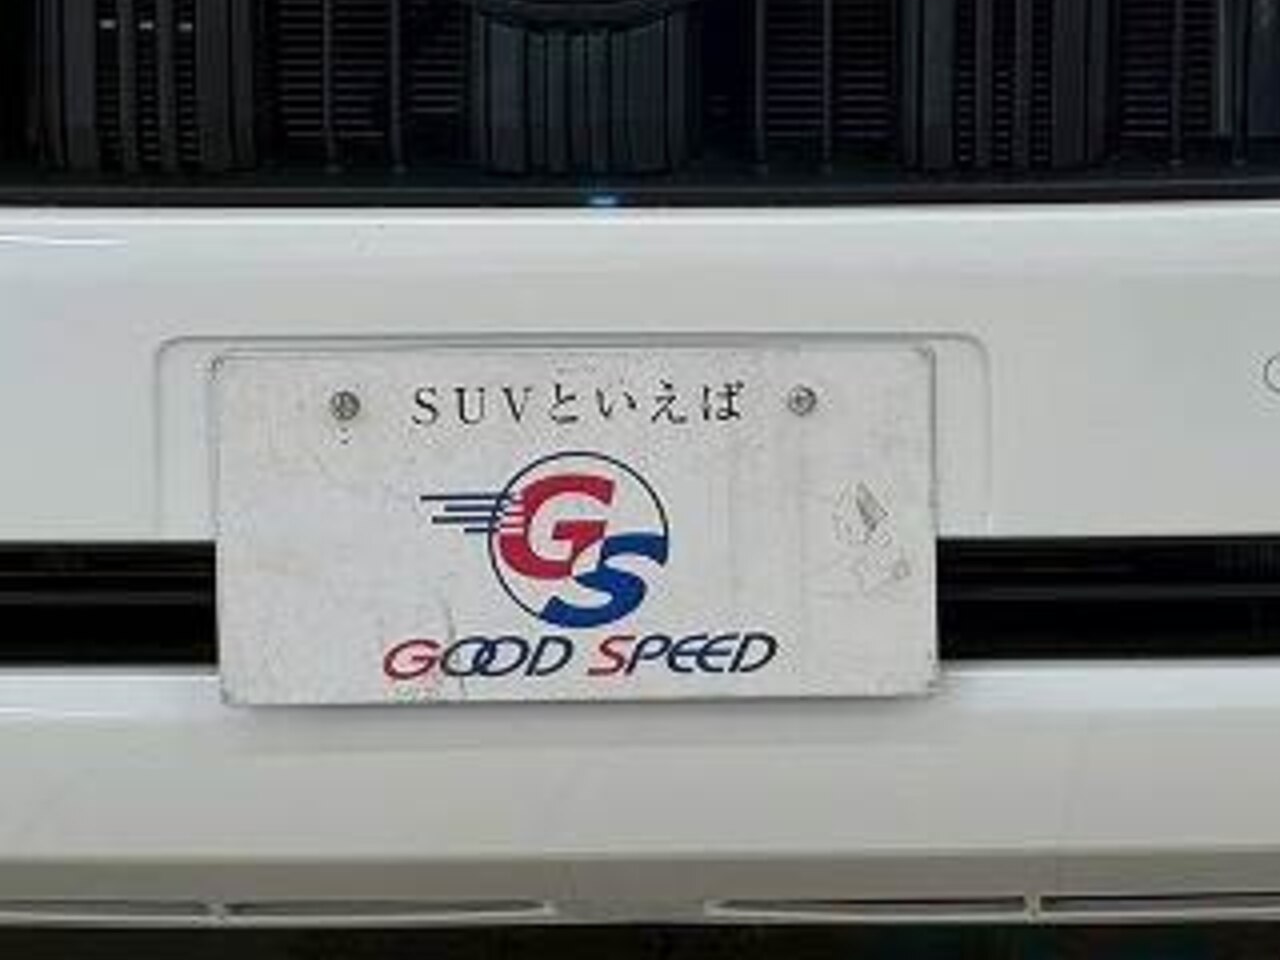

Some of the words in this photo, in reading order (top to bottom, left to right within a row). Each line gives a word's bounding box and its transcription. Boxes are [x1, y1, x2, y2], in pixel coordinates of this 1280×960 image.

[411, 381, 745, 425] SUVといえば
[383, 636, 574, 681] GOOD
[587, 632, 778, 677] SPEED
